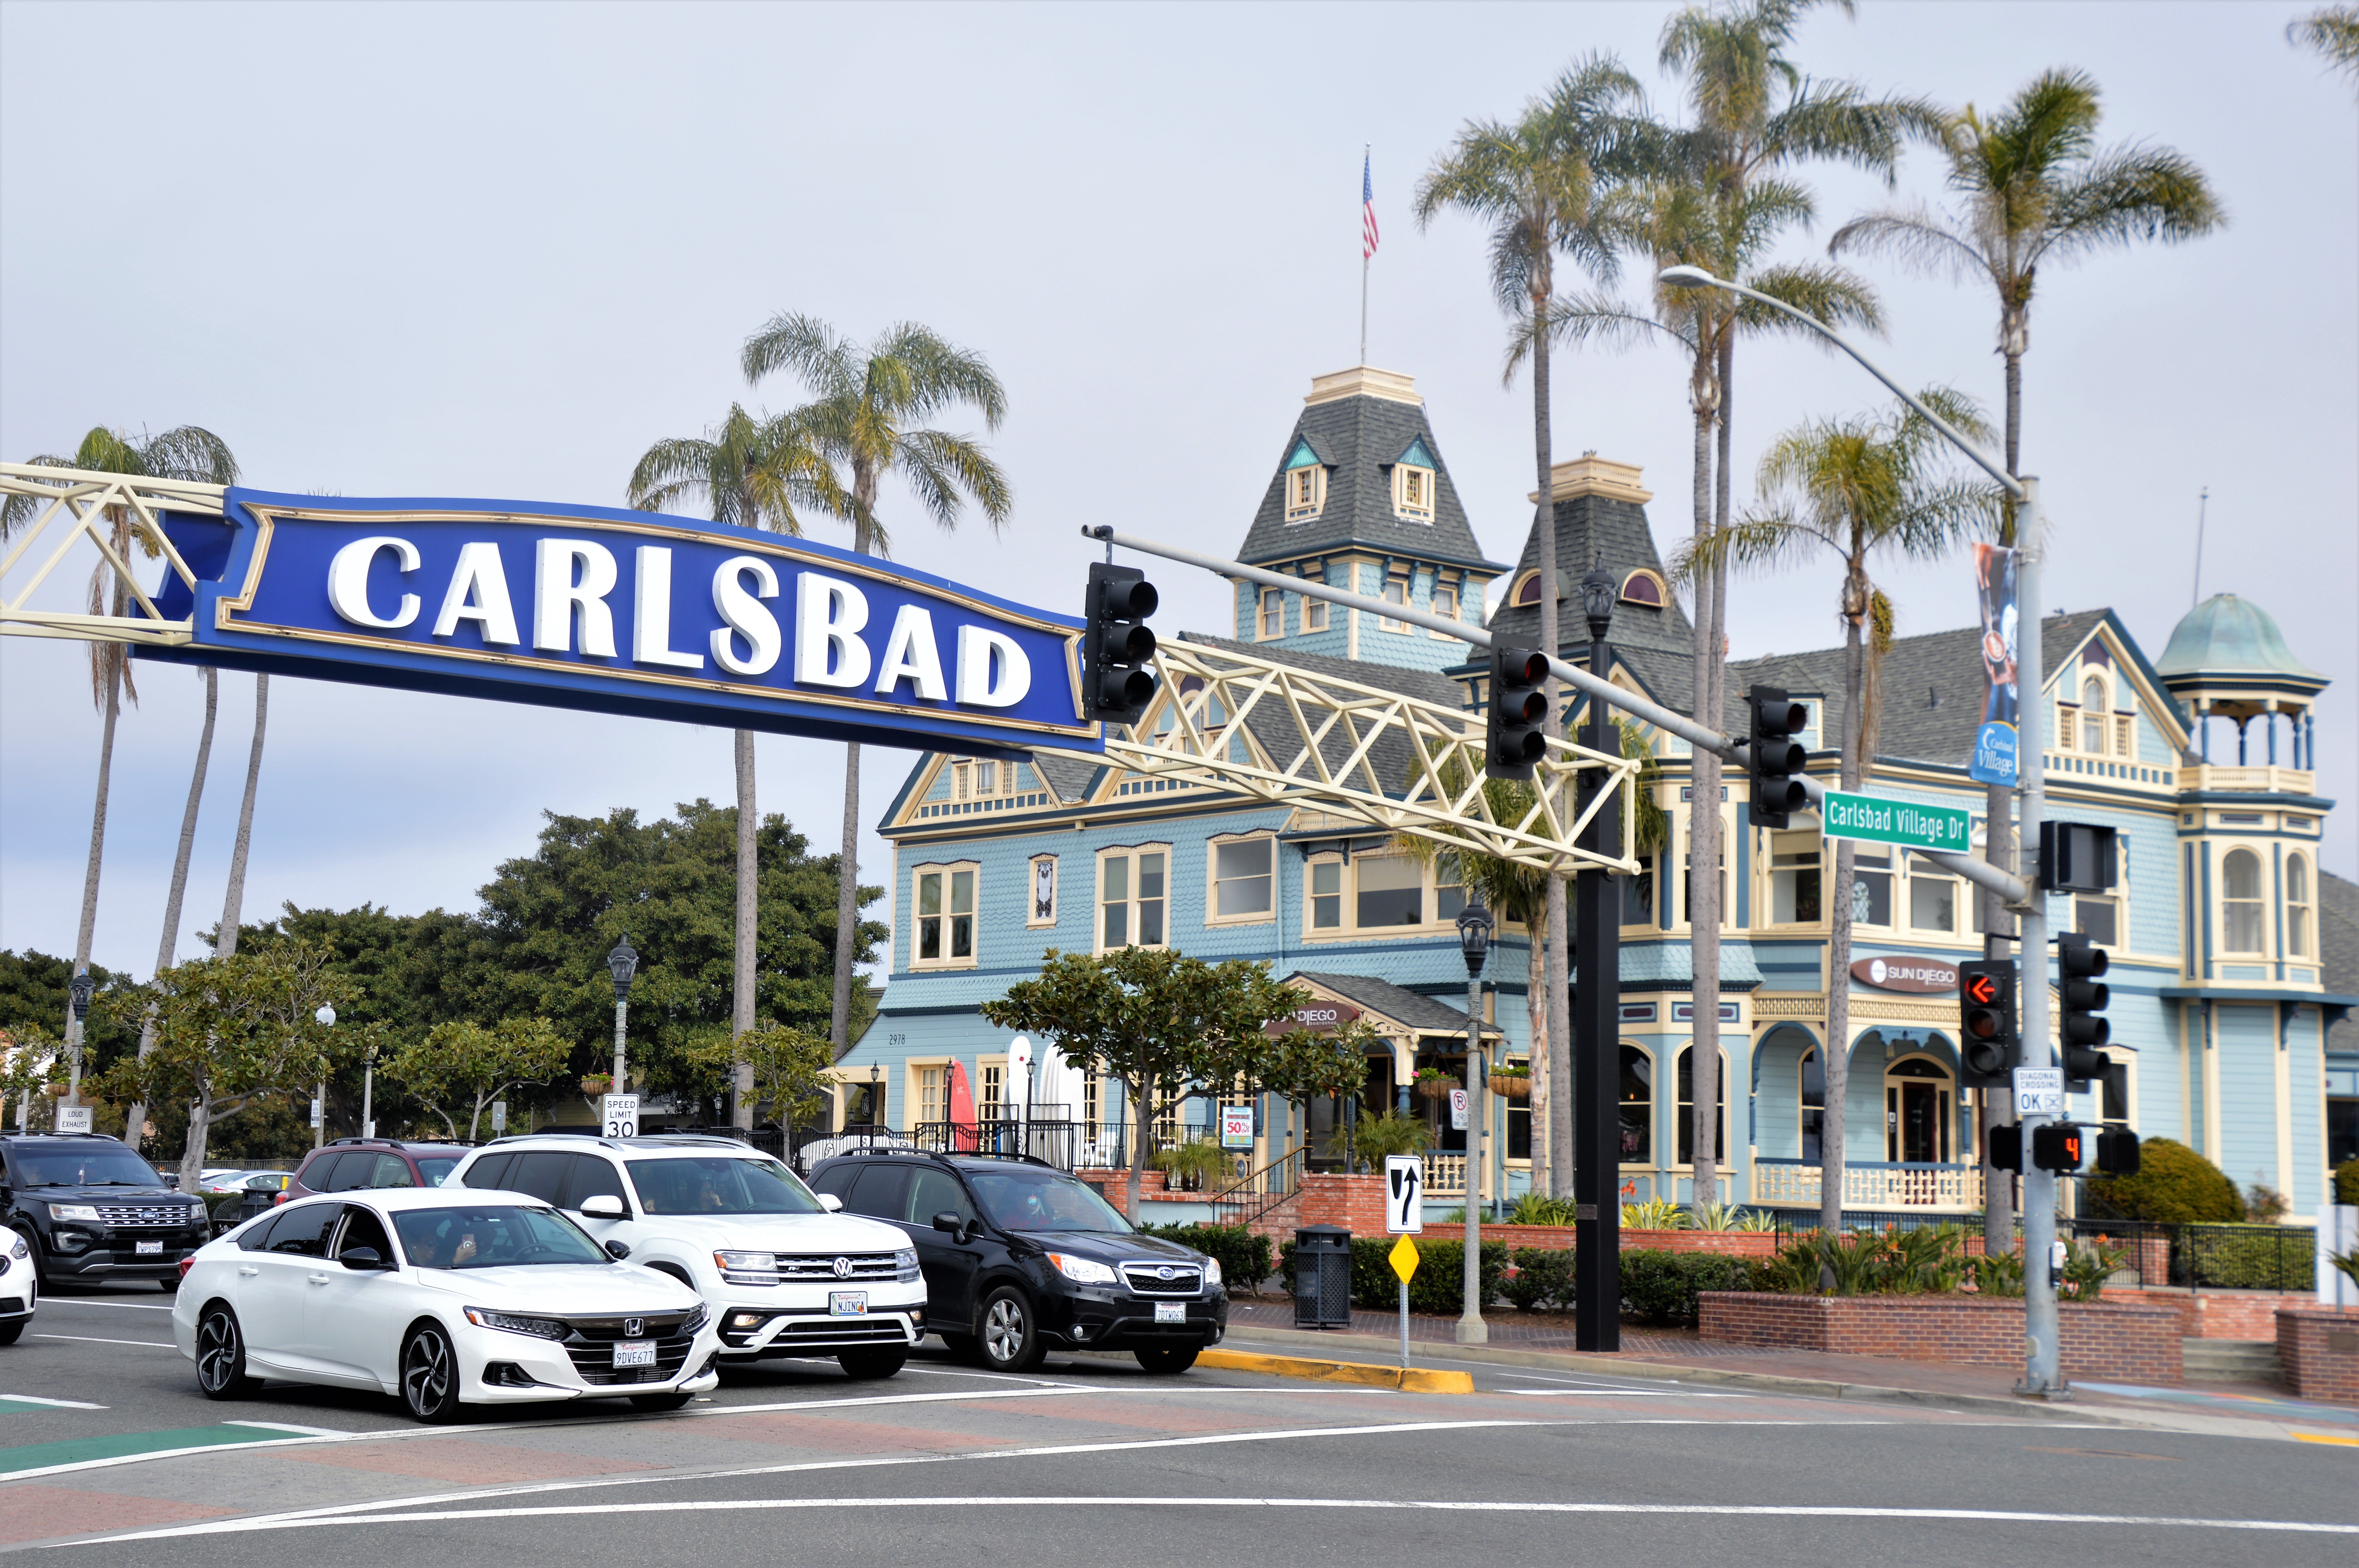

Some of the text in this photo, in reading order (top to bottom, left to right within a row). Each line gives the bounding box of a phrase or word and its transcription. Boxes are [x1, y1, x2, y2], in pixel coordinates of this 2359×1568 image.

[327, 536, 1032, 708] CARLSBAD
[1979, 749, 2013, 777] Village
[1830, 801, 1964, 843] Carlsbad Village Dr
[1888, 966, 1956, 986] SUN DIEGO
[1298, 1009, 1337, 1026] DIEGO
[889, 1034, 905, 1045] 2978
[2021, 1094, 2041, 1111] OK
[608, 1121, 633, 1137] 30
[2066, 1138, 2079, 1161] 4
[1158, 1310, 1183, 1320] 7DTW063
[616, 1351, 653, 1364] 9DVE677
